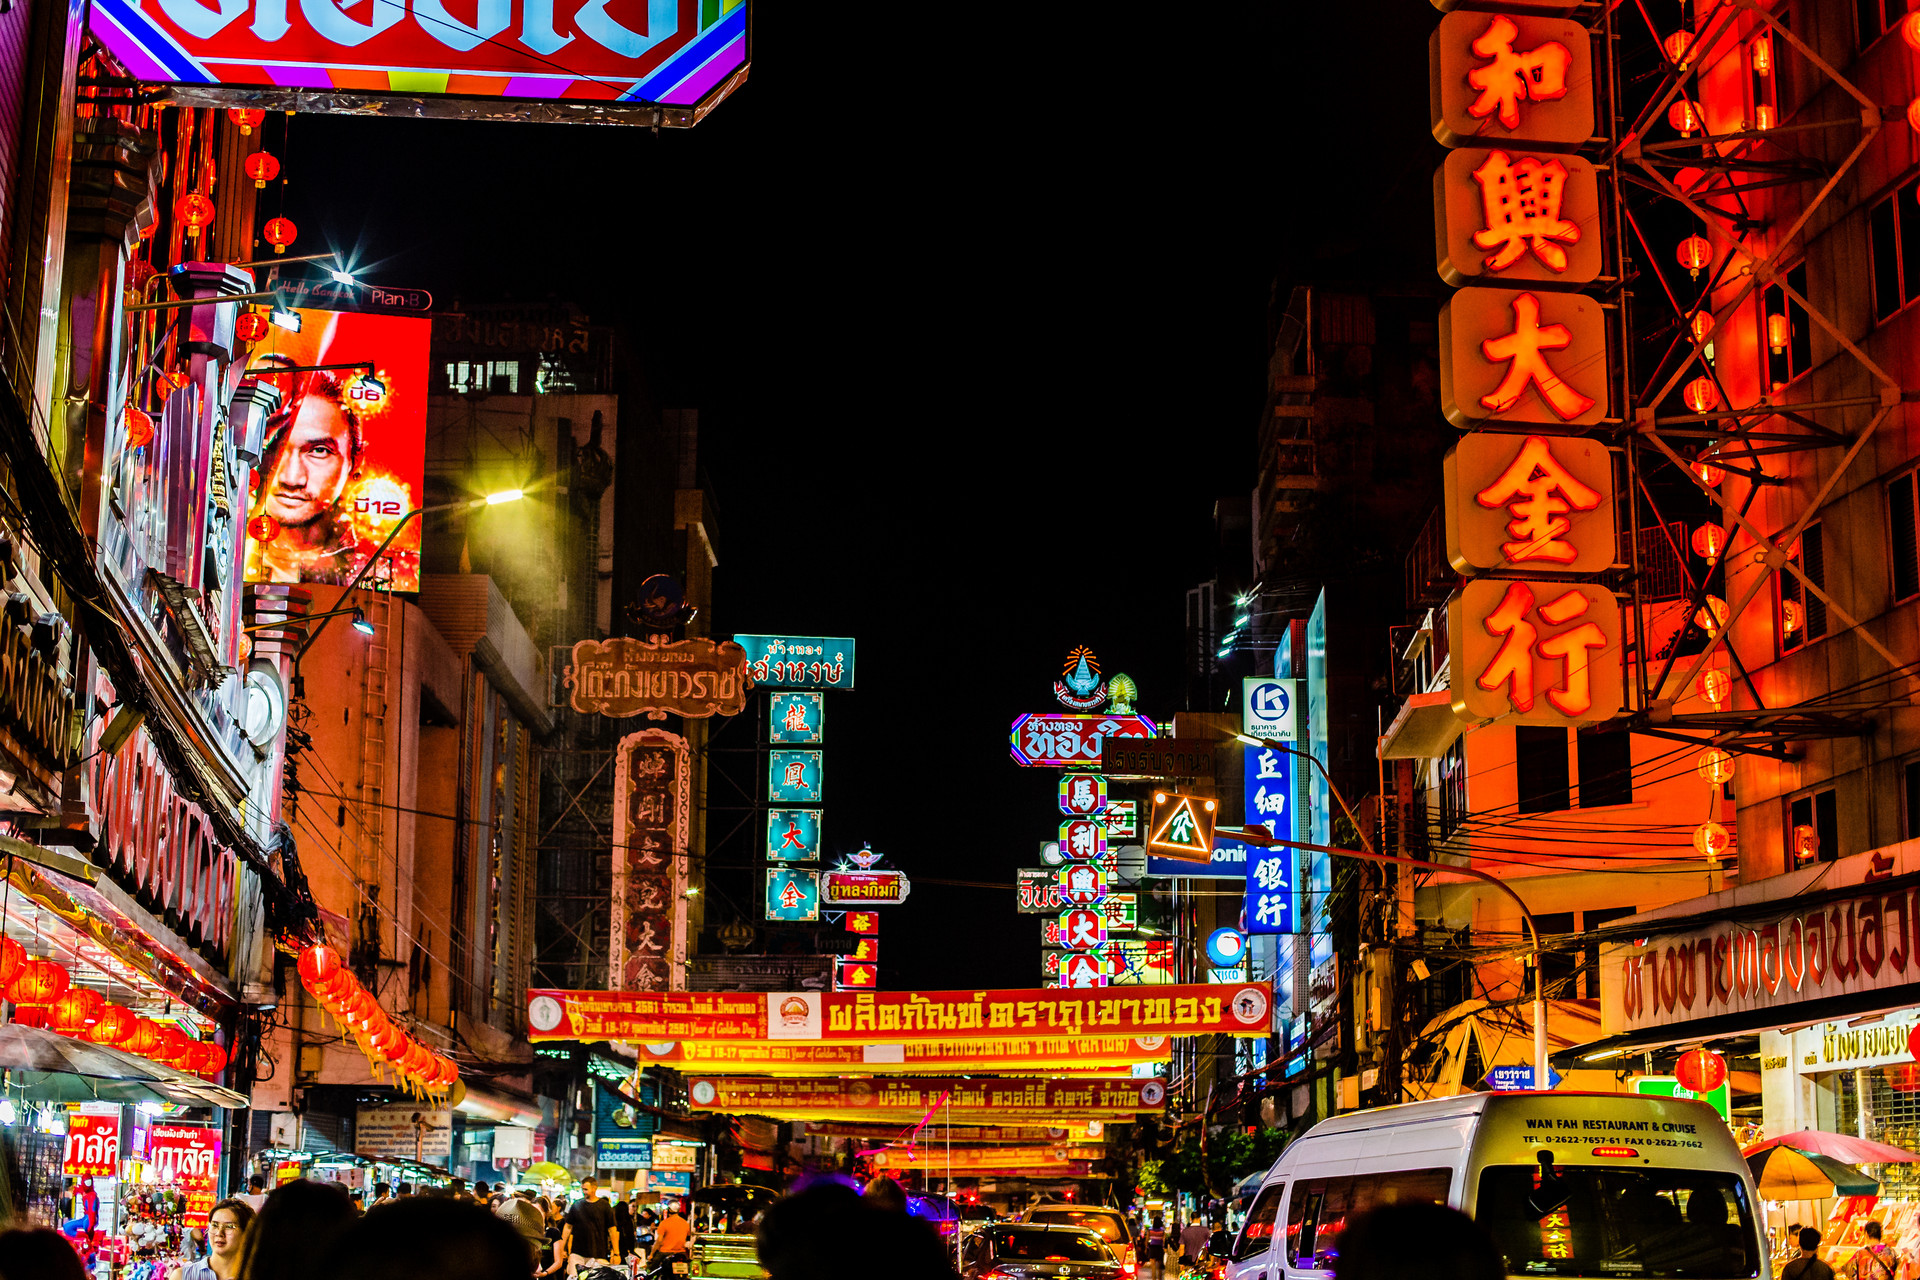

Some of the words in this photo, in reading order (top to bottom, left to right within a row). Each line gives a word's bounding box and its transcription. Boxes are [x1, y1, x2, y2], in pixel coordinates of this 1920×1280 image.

[1467, 14, 1607, 718] 和興大金行
[1027, 718, 1083, 732] ห้างทอง
[1105, 740, 1212, 772] โรงรับจำนำ
[1253, 749, 1289, 927] 丘細銀行
[1216, 970, 1239, 980] TISCO
[690, 1022, 707, 1037] Year
[708, 1021, 716, 1038] of
[716, 1021, 741, 1035] Golden
[742, 1021, 757, 1039] Dog
[1494, 1069, 1531, 1080] เยาวราช
[1526, 1119, 1553, 1129] WAN
[1557, 1119, 1578, 1129] FAH
[1583, 1120, 1649, 1131] RESTAURANT
[1652, 1122, 1660, 1131] &
[1662, 1122, 1697, 1134] CRUISE
[1523, 1135, 1544, 1143] TEL.
[1545, 1136, 1621, 1145] 0-2622-7657-61
[1625, 1137, 1644, 1146] FAX
[1646, 1138, 1703, 1148] 0-2622-7662
